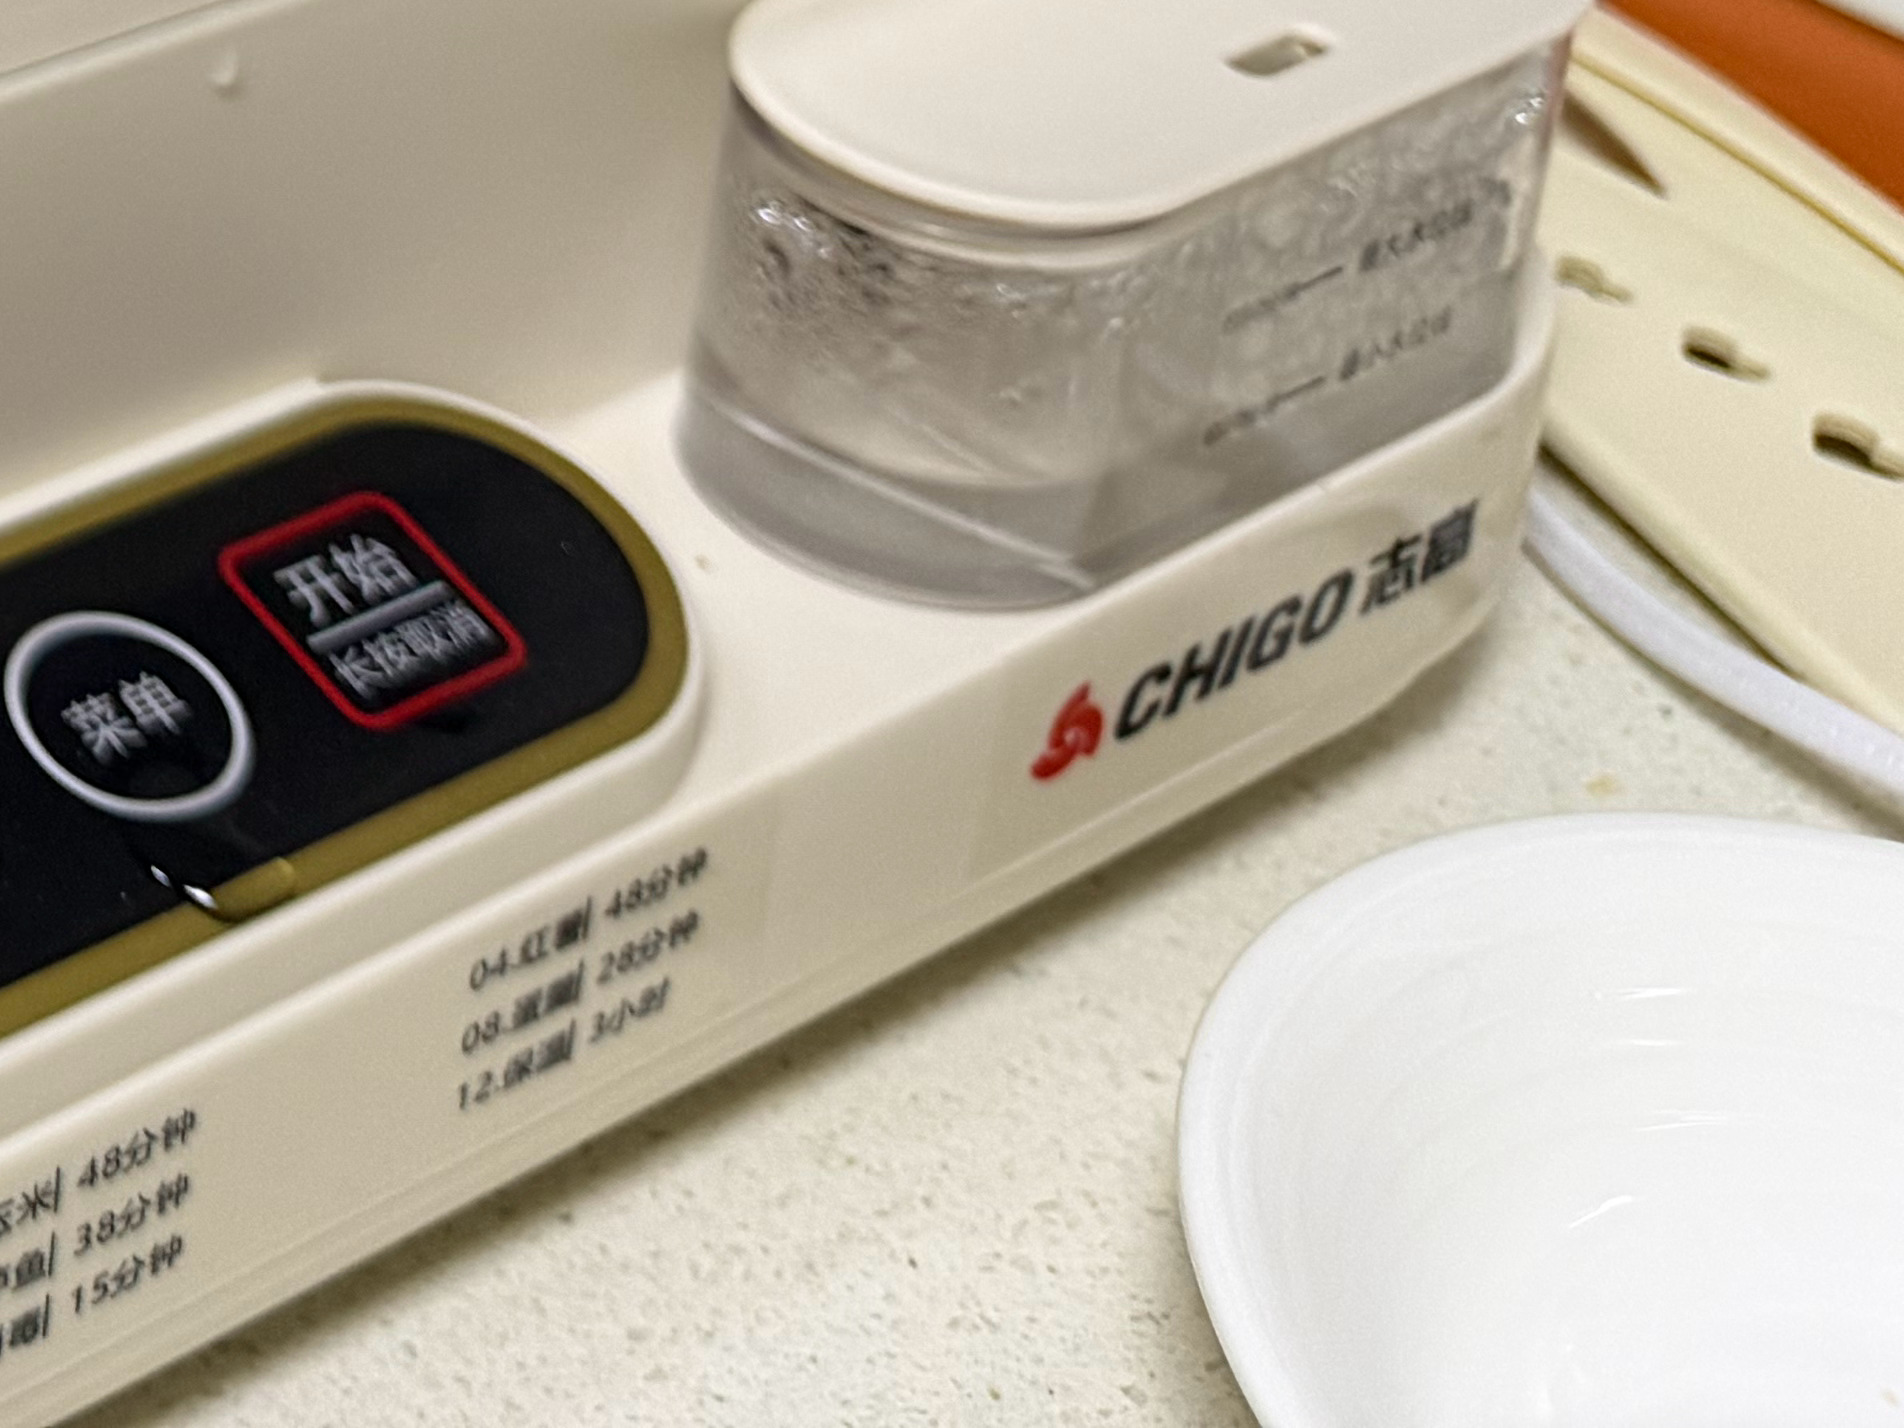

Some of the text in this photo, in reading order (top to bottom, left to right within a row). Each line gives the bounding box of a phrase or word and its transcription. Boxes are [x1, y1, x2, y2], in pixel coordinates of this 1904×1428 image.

[272, 532, 421, 629] 开始
[1113, 498, 1480, 742] CHIGO 志高
[327, 597, 494, 701] 长按取消
[60, 670, 193, 766] 菜单
[76, 1107, 197, 1189] 48分钟
[73, 1172, 191, 1257] 38分钟
[71, 1233, 184, 1315] 15分钟
